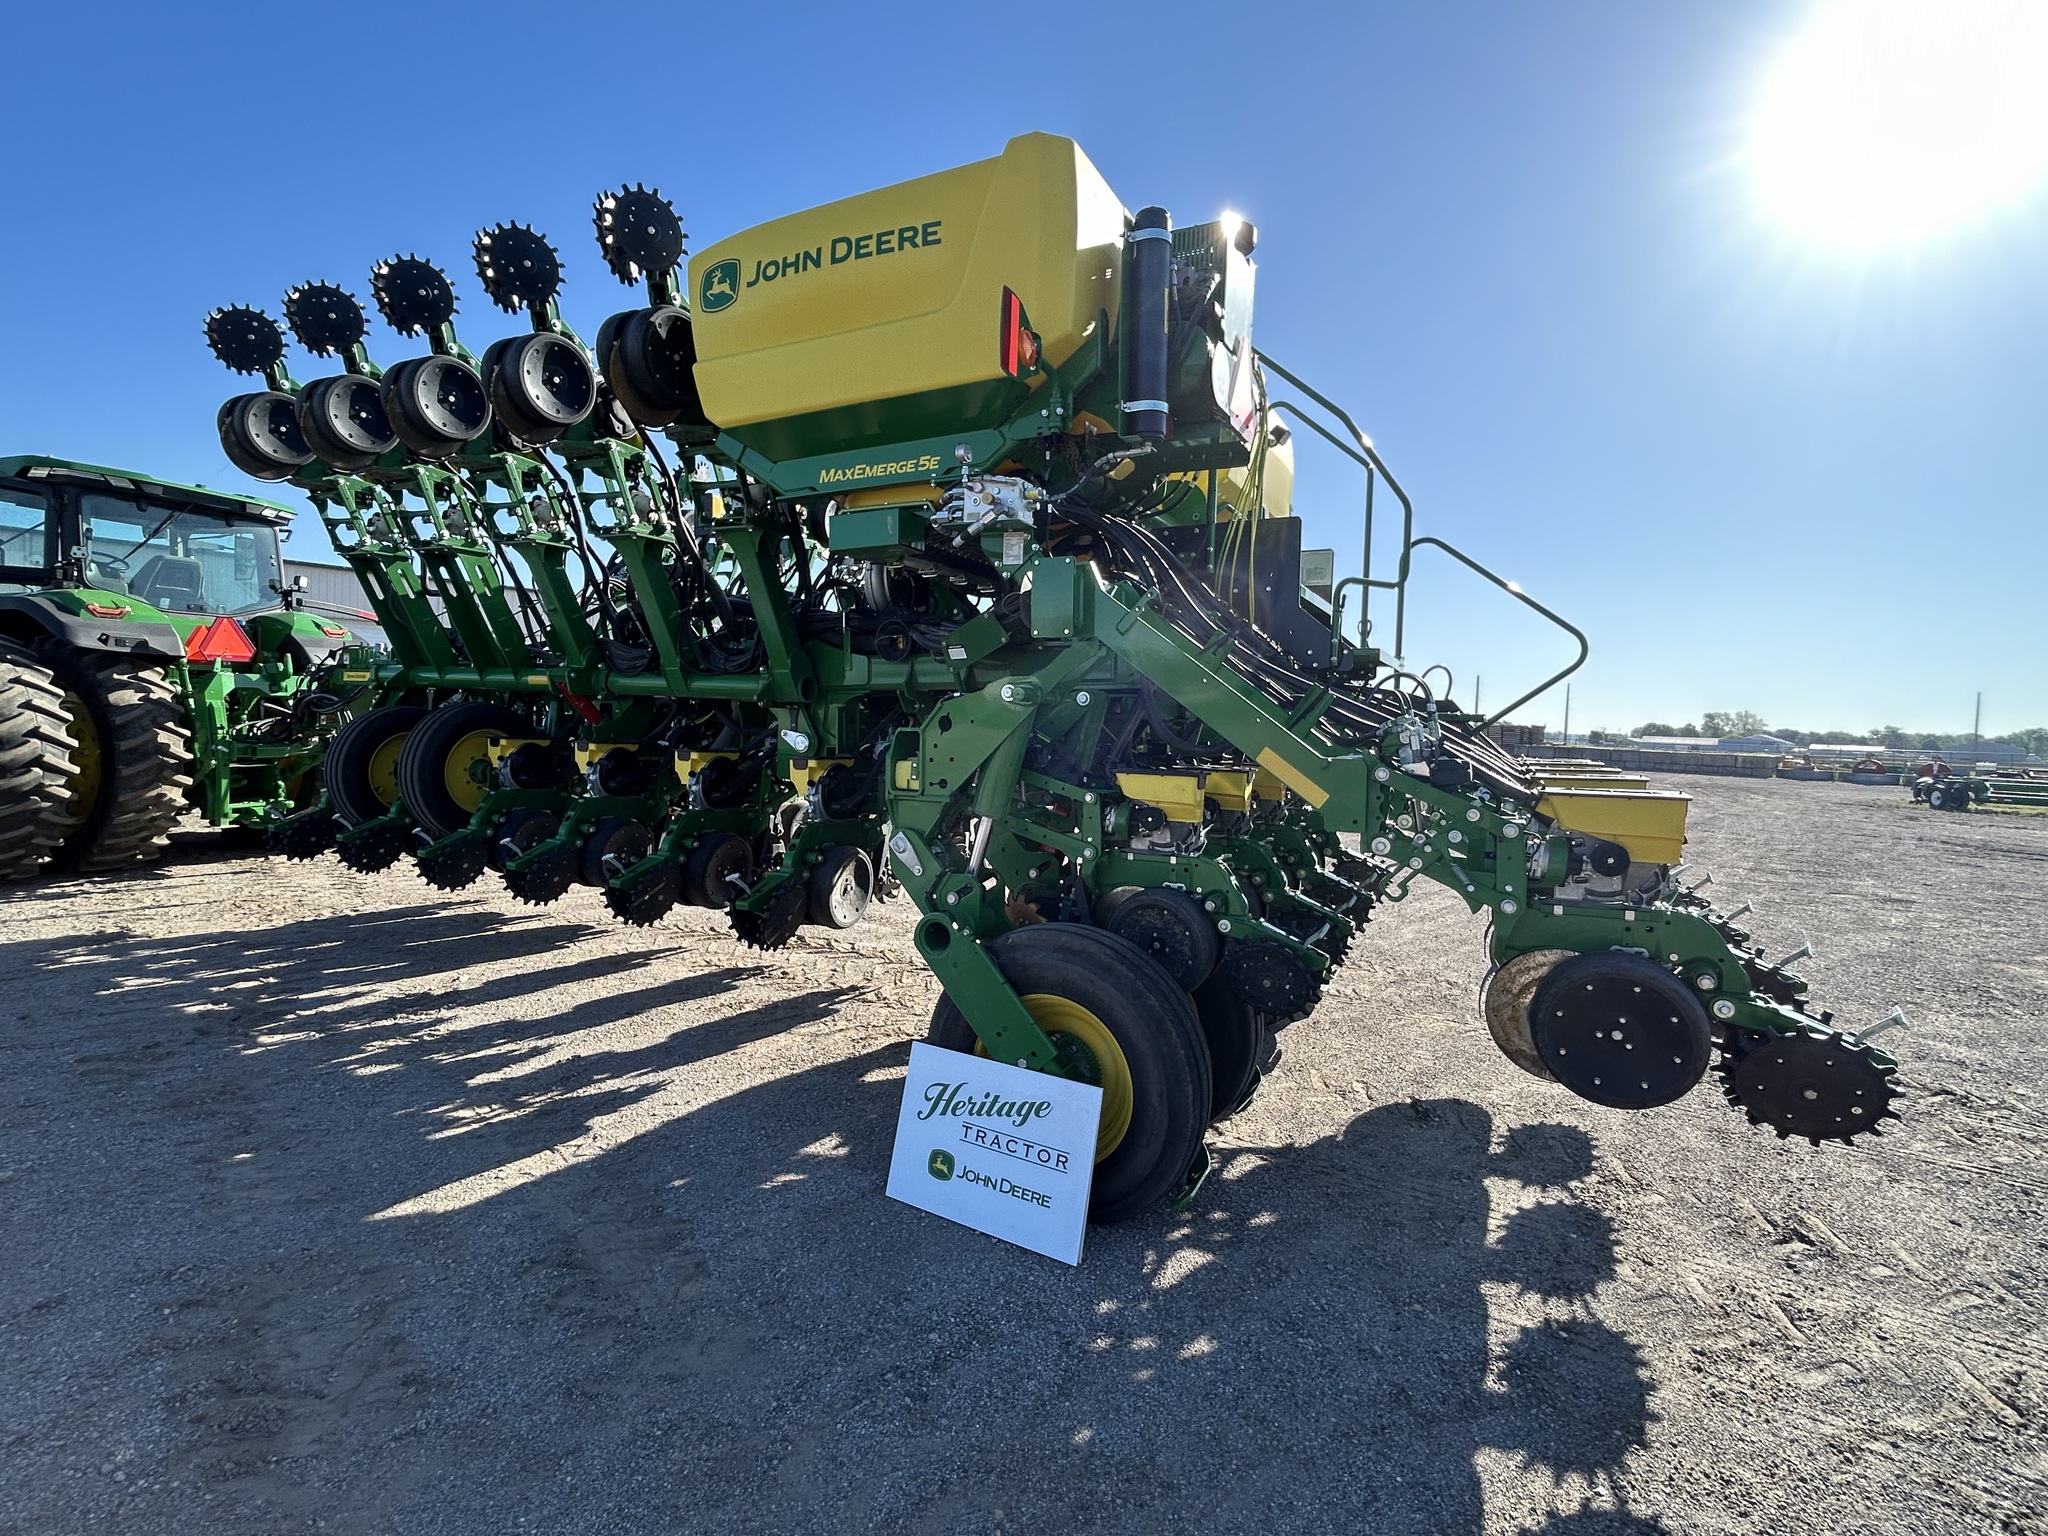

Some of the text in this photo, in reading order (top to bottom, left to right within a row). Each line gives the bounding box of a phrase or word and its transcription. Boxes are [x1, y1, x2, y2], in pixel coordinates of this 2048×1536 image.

[746, 220, 942, 288] JOHN DEERE
[917, 1082, 1053, 1127] Heritage
[962, 1124, 1069, 1170] TRACTOR
[956, 1165, 1052, 1209] JOHN DEERE
